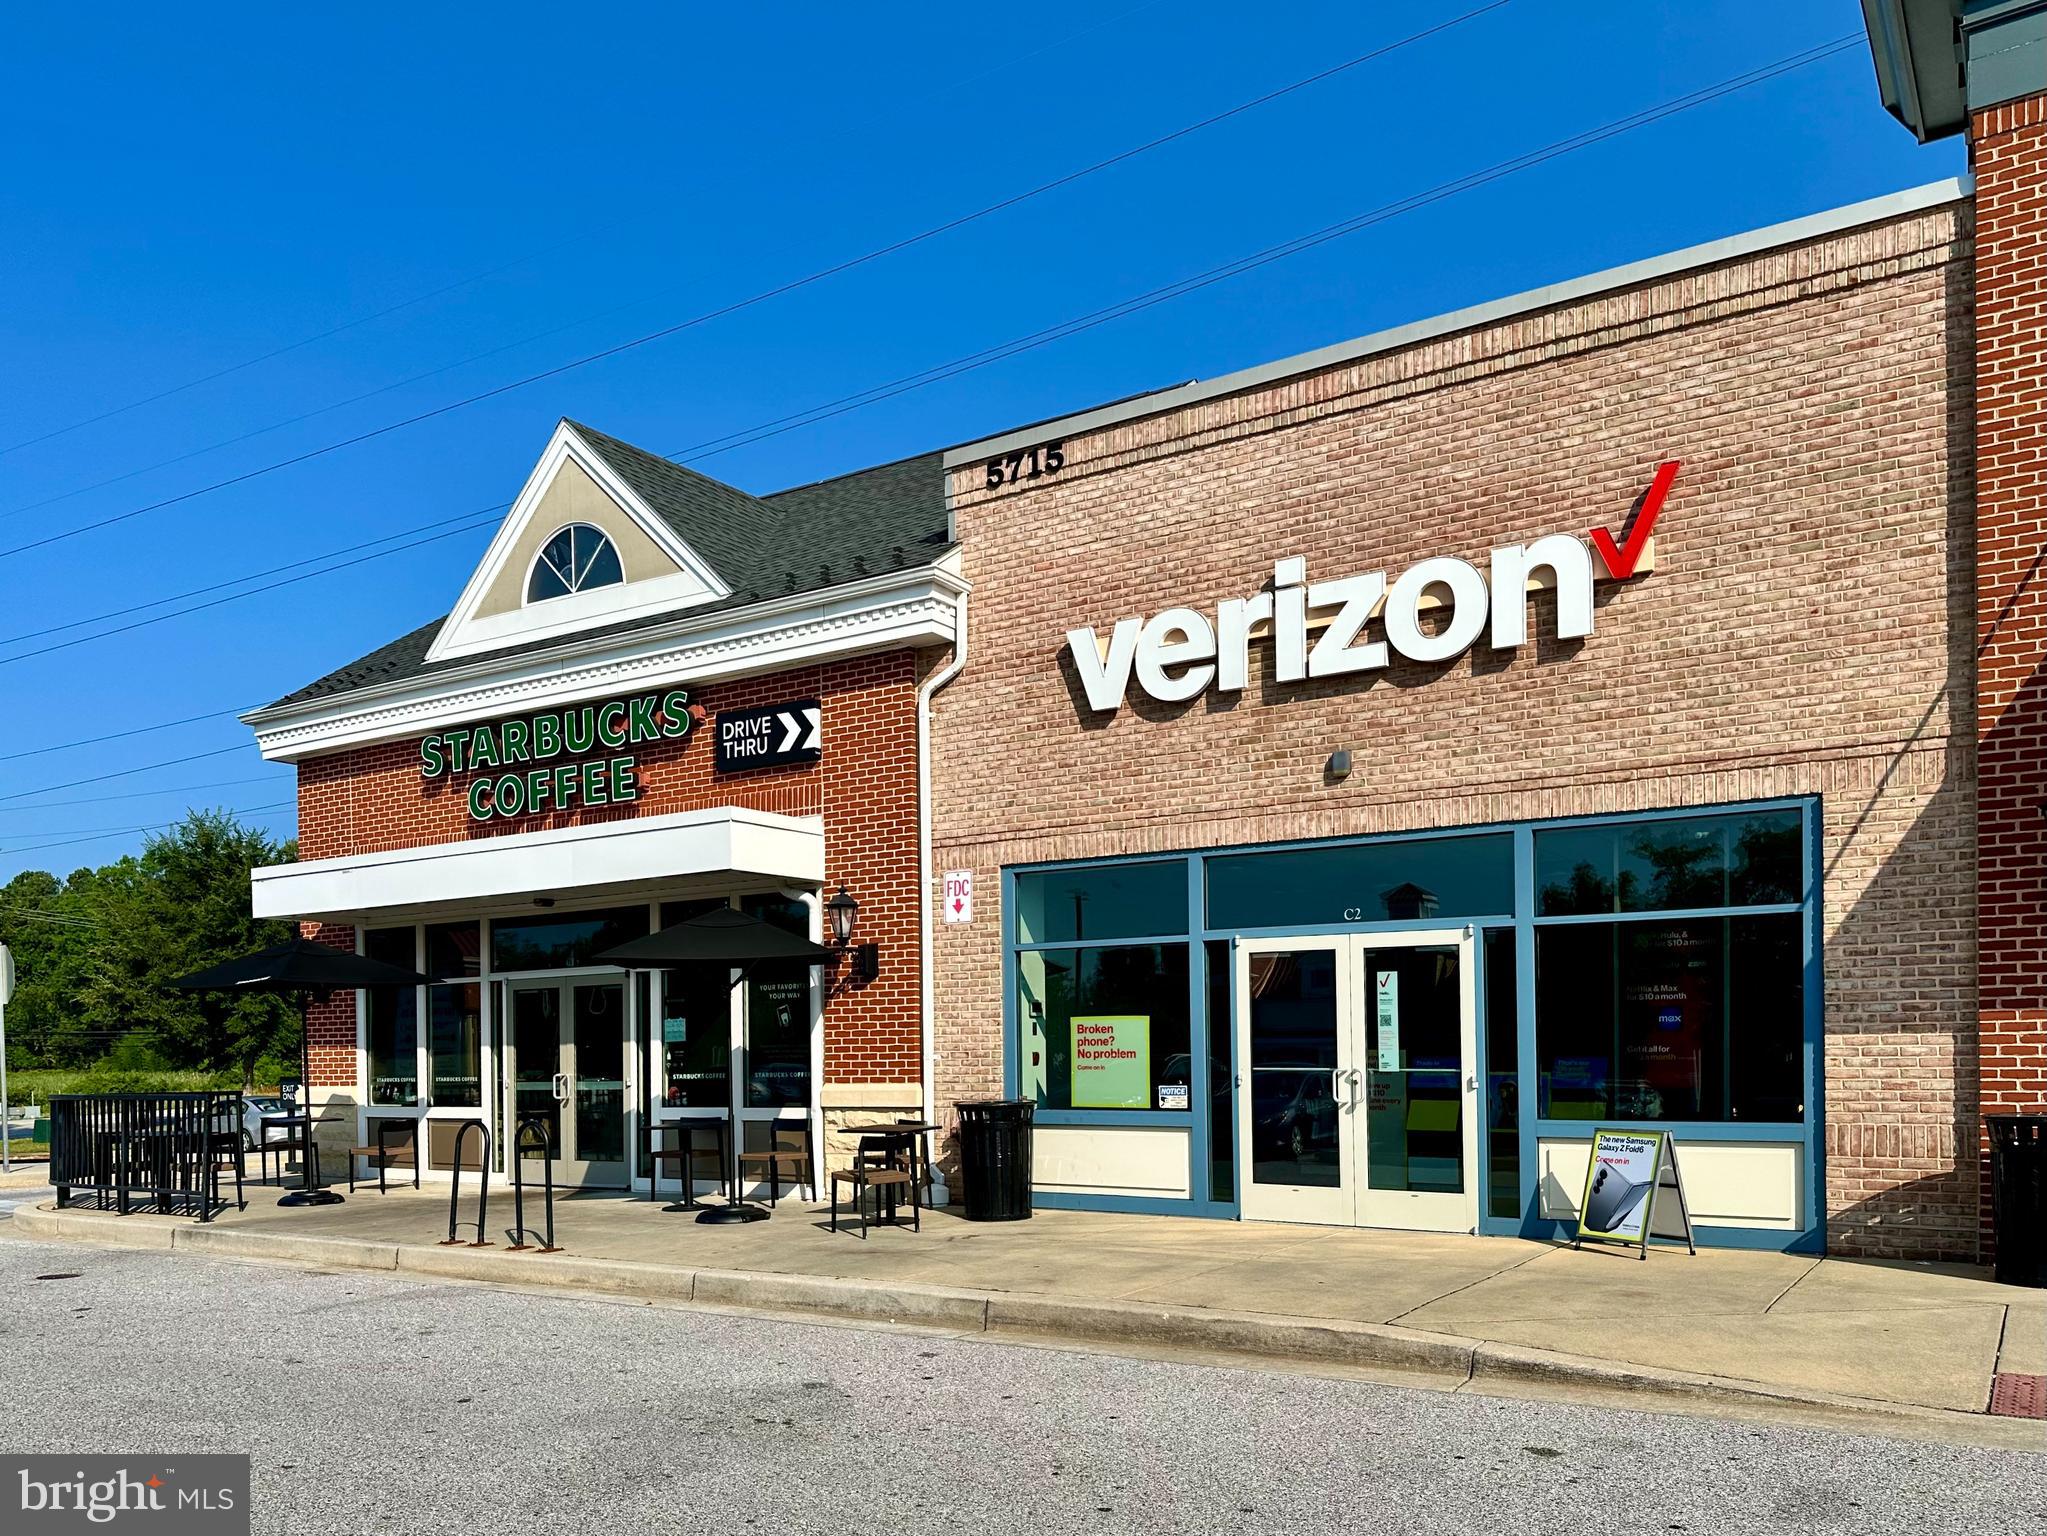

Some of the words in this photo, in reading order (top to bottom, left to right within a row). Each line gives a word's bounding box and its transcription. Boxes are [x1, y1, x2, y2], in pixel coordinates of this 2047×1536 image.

[986, 446, 1064, 490] 5715
[1067, 533, 1595, 711] verizon
[420, 691, 690, 777] STARBUCKS
[723, 716, 771, 740] DRIVE
[723, 736, 768, 759] THRU
[468, 756, 637, 820] COFFEE
[947, 879, 969, 897] FDC
[1344, 908, 1361, 920] C2
[1077, 1025, 1114, 1034] Broken
[1077, 1036, 1115, 1049] phone?
[1077, 1049, 1092, 1059] No
[1093, 1048, 1136, 1060] problem
[283, 1084, 294, 1092] EXIT
[1598, 1143, 1619, 1152] Galaxy
[1625, 1145, 1644, 1153] Fold6
[1625, 1137, 1656, 1147] Samsung
